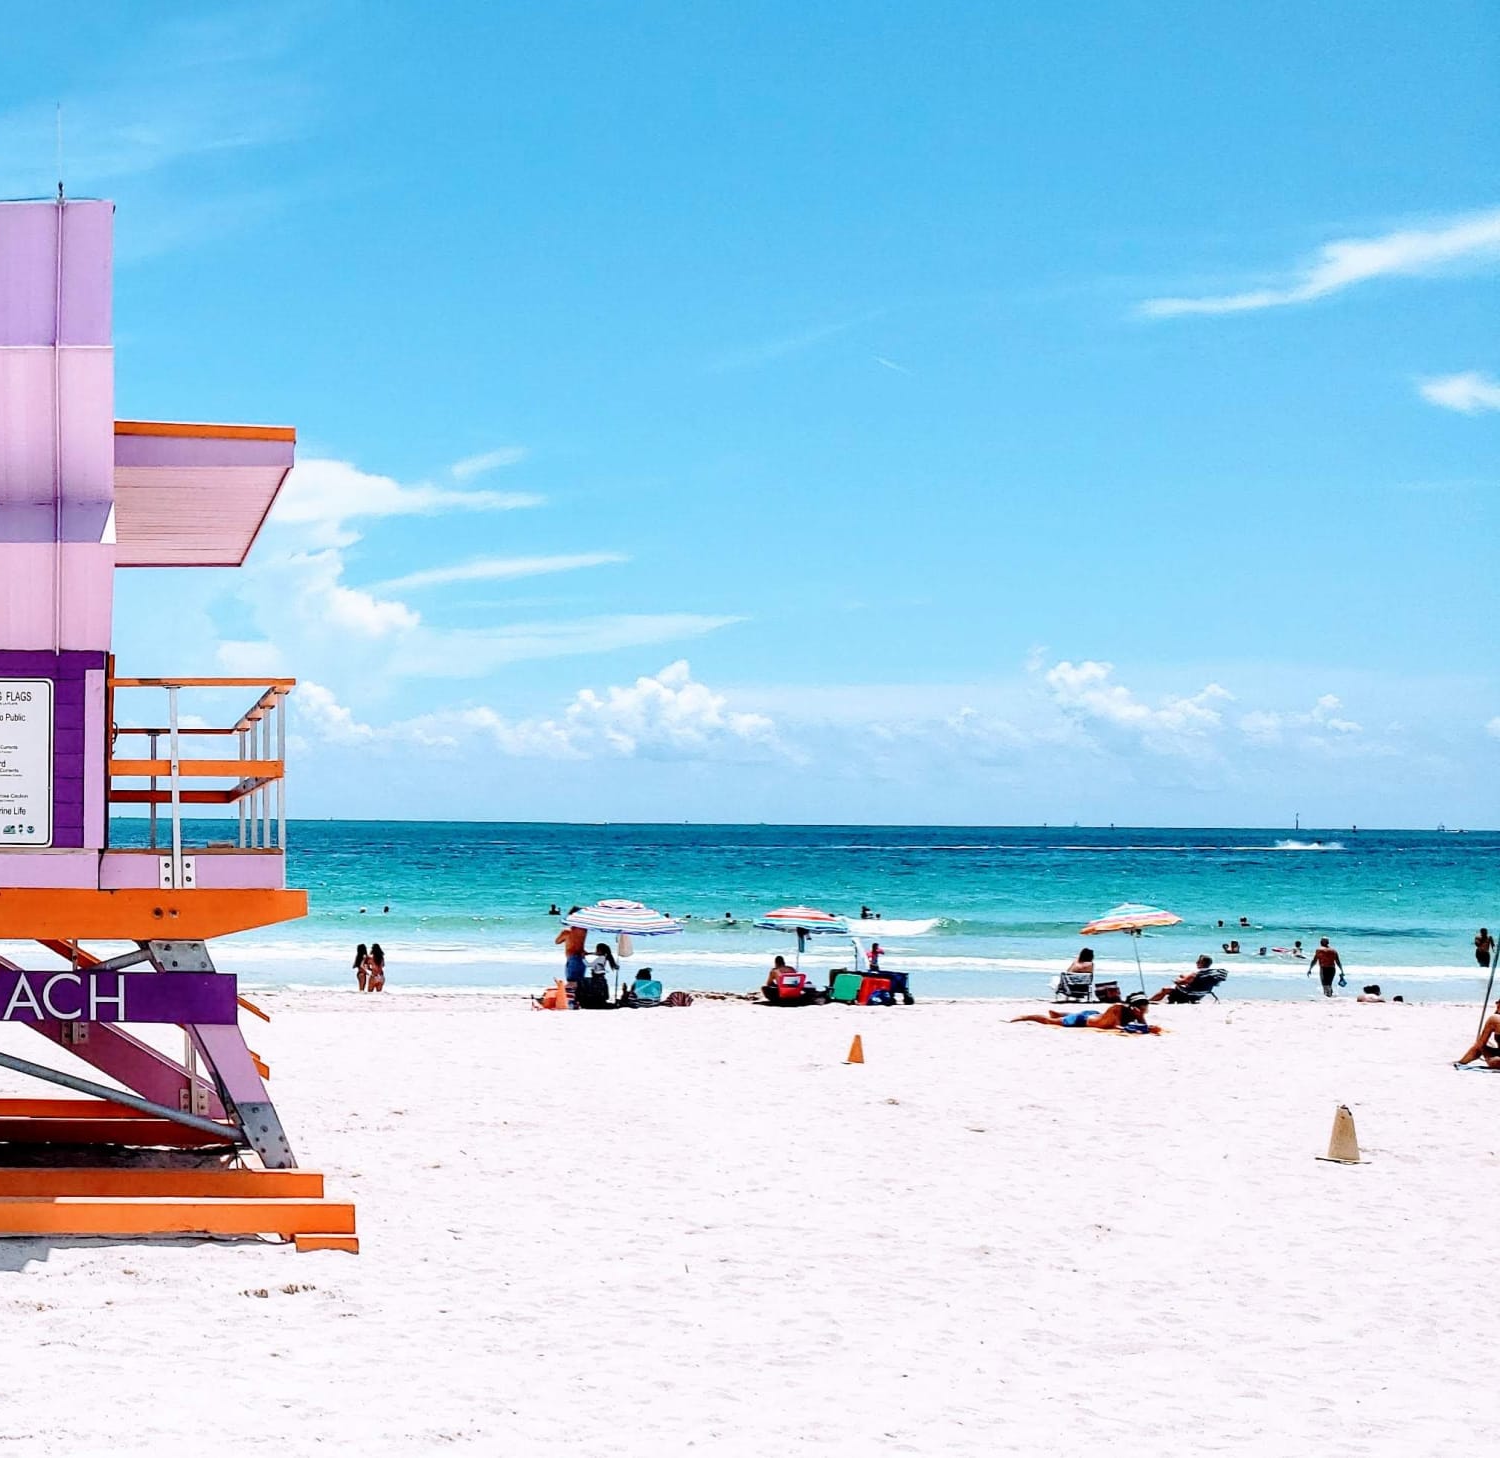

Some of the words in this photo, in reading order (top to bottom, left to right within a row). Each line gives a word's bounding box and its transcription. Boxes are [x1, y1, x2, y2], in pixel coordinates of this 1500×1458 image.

[6, 691, 32, 702] FLAGS
[5, 713, 26, 721] Public
[13, 807, 26, 815] Life
